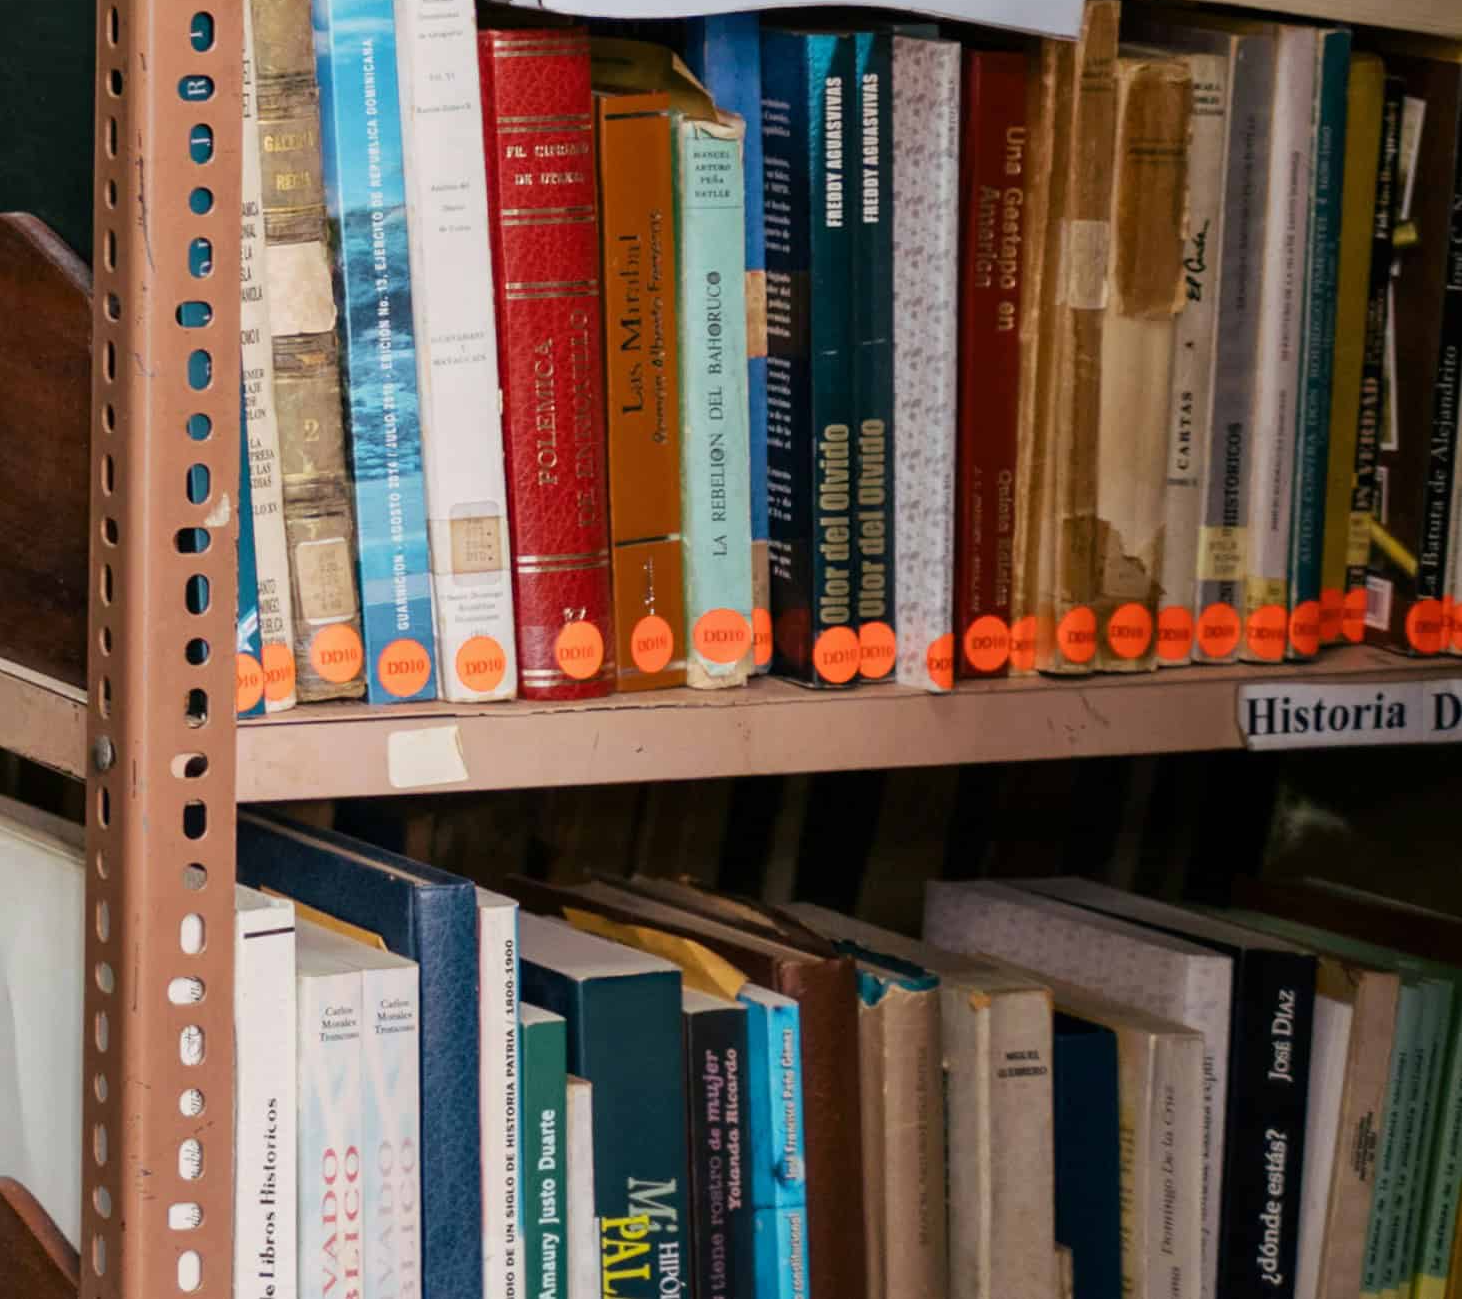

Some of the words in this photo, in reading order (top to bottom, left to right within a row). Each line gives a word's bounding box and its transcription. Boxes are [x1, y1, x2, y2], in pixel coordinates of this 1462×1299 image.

[824, 76, 843, 169] AGUASVIVAS
[861, 73, 879, 165] AGUASVIVAS
[1006, 127, 1027, 177] Una
[826, 172, 843, 228] FREDDY
[863, 168, 880, 224] FREDDY
[1000, 189, 1024, 289] Gestapo
[706, 270, 722, 375] BAHORUCO
[997, 299, 1015, 332] en
[537, 337, 557, 485] POLEMICA
[709, 383, 724, 422] DEL
[302, 419, 320, 443] 2
[711, 433, 727, 522] REBELION
[820, 423, 850, 511] Olvido
[858, 418, 886, 506] Olvido
[1221, 422, 1243, 529] HISTORICOS
[714, 534, 728, 556] LA
[820, 515, 849, 561] del
[858, 510, 885, 555] del
[820, 567, 849, 624] Olor
[858, 561, 885, 617] Olor
[319, 646, 357, 665] DD10
[702, 627, 745, 644] DD10
[387, 659, 425, 676] DD10
[464, 659, 503, 676] DD10
[1246, 692, 1406, 739] Historia
[381, 998, 410, 1011] Carlos
[504, 939, 515, 1015] 1800-1900
[319, 1031, 360, 1043] Troncoso
[321, 1019, 358, 1031] Morales
[325, 1005, 354, 1018] Carlos
[374, 1021, 415, 1036] Troncoso
[377, 1010, 413, 1024] Morales
[505, 1028, 516, 1078] PATRIA
[702, 1049, 723, 1123] mujer
[723, 1048, 739, 1123] Ricardo
[505, 1081, 516, 1148] HISTORIA
[538, 1109, 556, 1170] Duarte
[705, 1127, 722, 1151] de
[258, 1097, 277, 1201] Historicos
[505, 1152, 516, 1172] DE
[725, 1128, 742, 1211] Yolanda
[1264, 1128, 1288, 1196] estás?
[505, 1176, 516, 1219] SIGLO
[538, 1178, 559, 1225] Justo
[705, 1155, 724, 1225] rostro
[257, 1209, 276, 1277] Libros
[505, 1223, 516, 1243] UN
[505, 1247, 516, 1267] DE
[708, 1232, 726, 1289] tiene
[1256, 1201, 1284, 1285] ¿dónde
[538, 1232, 560, 1299] Amaury
